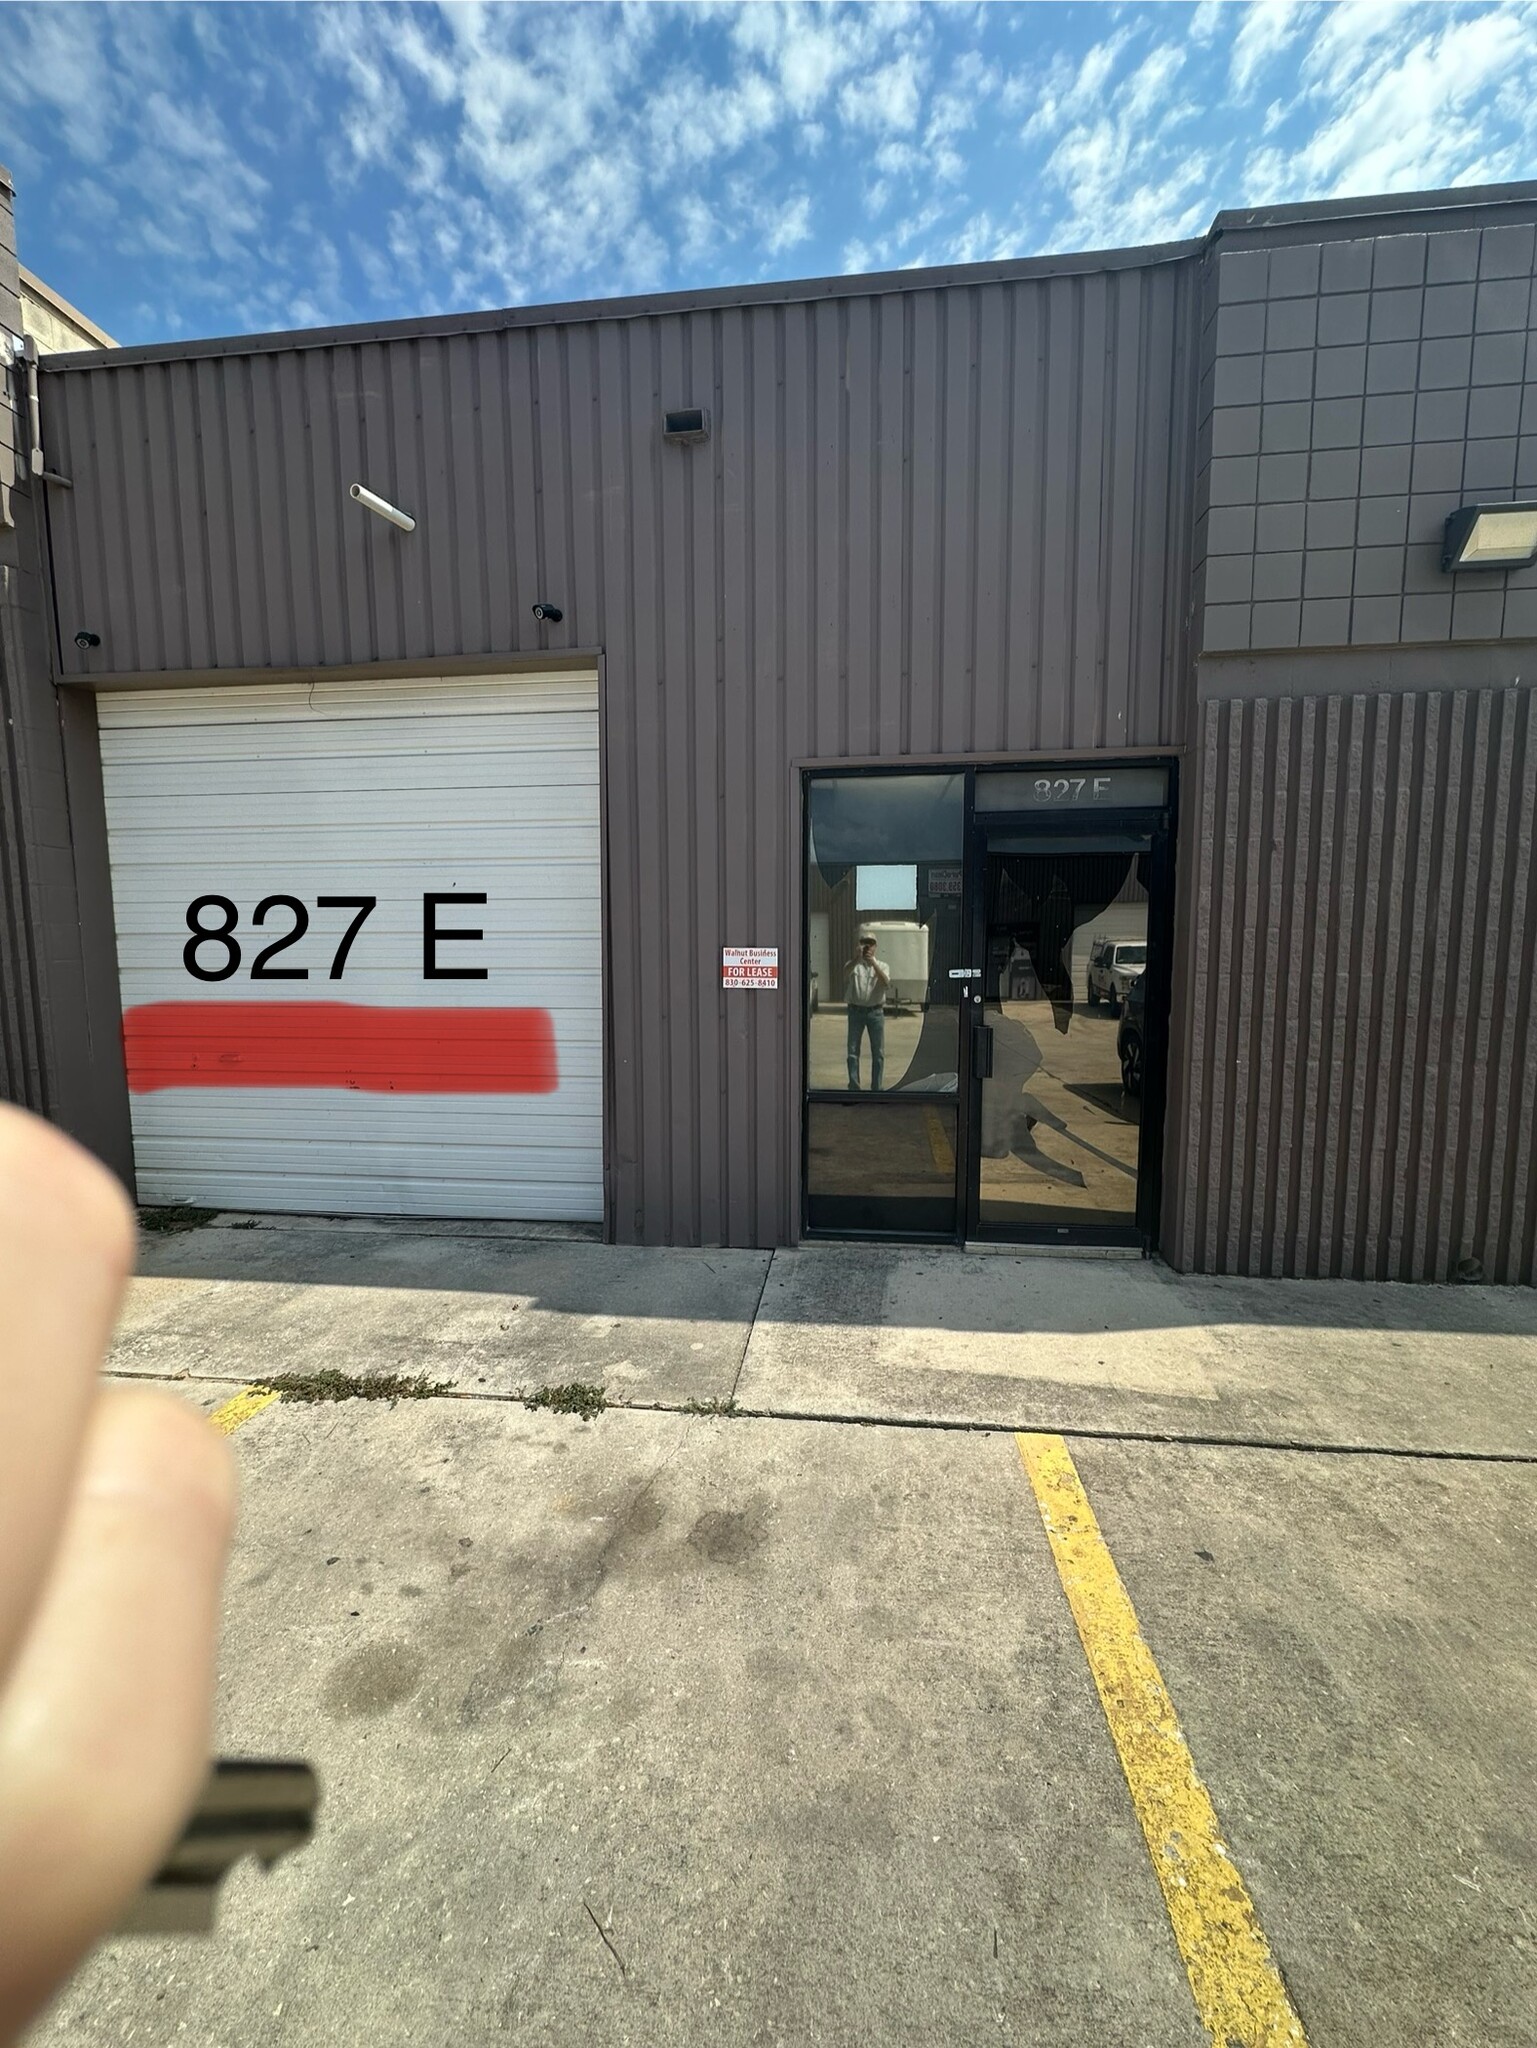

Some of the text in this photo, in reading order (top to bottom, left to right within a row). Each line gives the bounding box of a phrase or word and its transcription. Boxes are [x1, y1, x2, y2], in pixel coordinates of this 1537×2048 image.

[1033, 778, 1086, 801] 827
[725, 949, 776, 957] Walnut Business
[740, 957, 761, 965] Center
[728, 967, 773, 977] FOR LEASE
